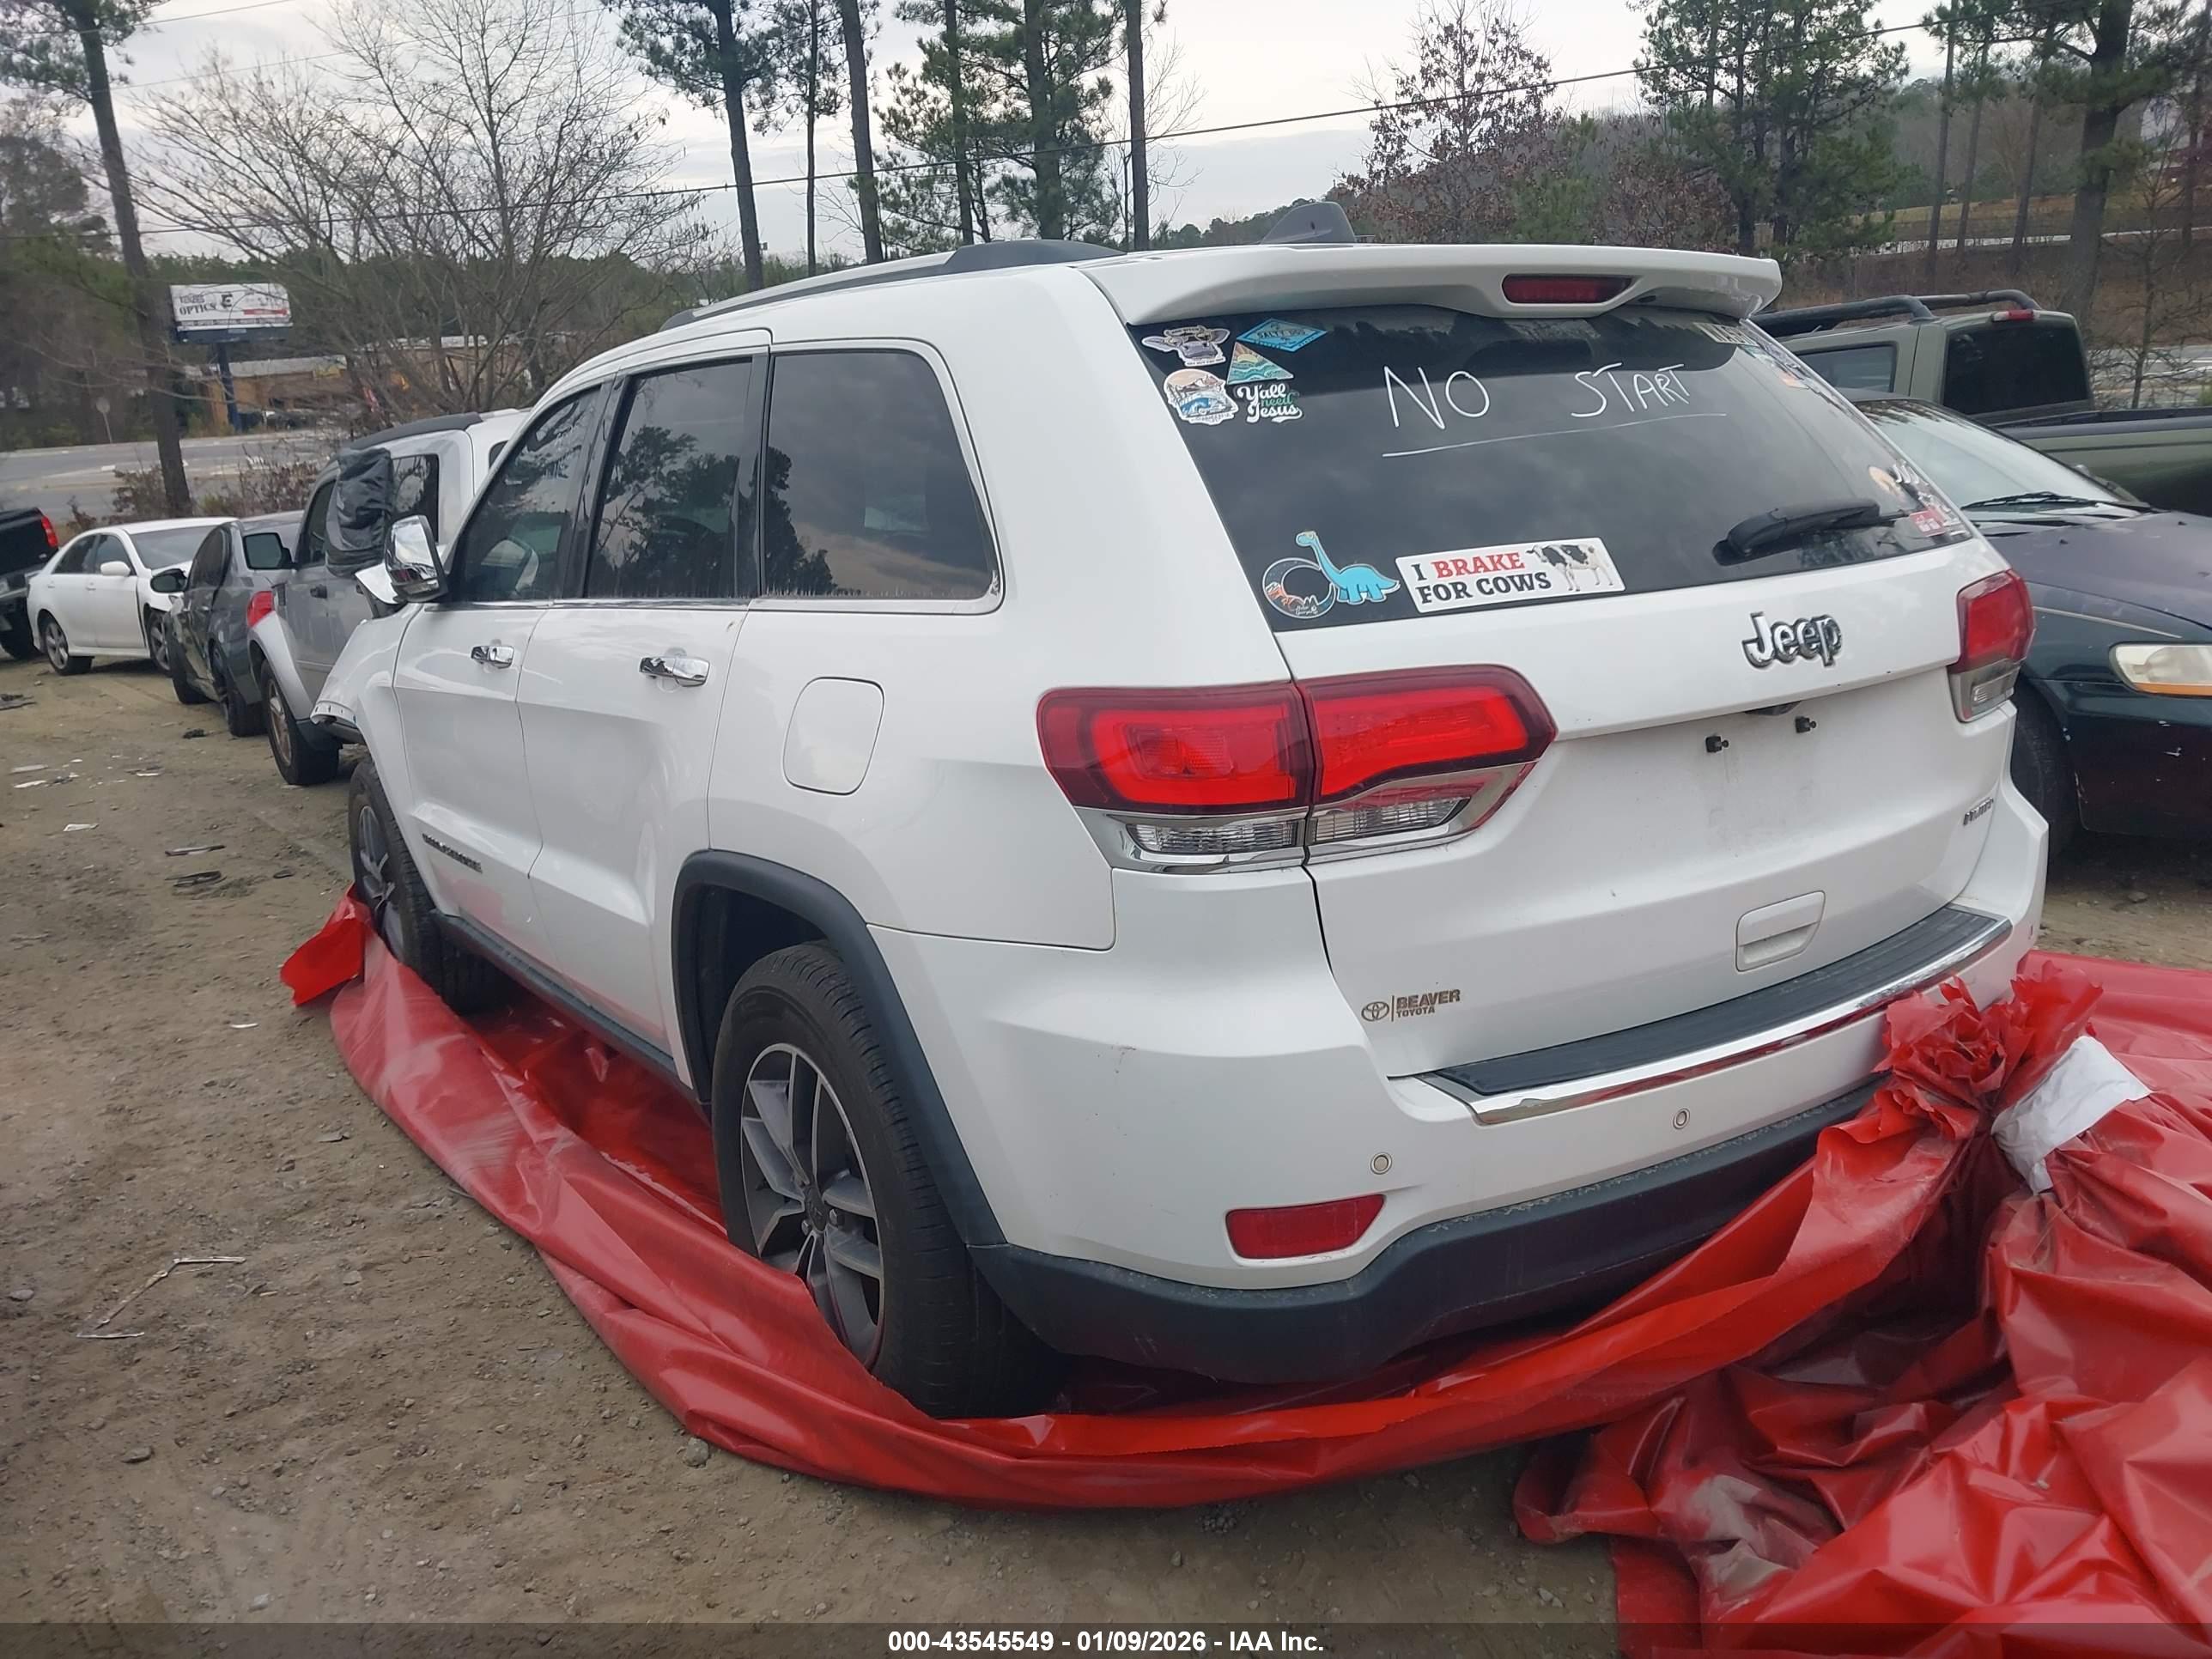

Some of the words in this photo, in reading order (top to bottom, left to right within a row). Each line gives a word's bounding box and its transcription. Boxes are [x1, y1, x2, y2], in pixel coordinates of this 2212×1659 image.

[179, 302, 216, 315] OPTICS
[1237, 383, 1286, 406] Y'all
[1261, 392, 1296, 407] need
[1383, 365, 1490, 429] NO
[1571, 362, 1691, 417] START
[1246, 403, 1303, 422] Jesus
[1411, 563, 1427, 581] I
[1431, 552, 1525, 579] BRAKE
[1415, 581, 1474, 604] FOR
[1476, 571, 1552, 595] COWS
[1741, 611, 1842, 668] Jeep
[1396, 989, 1461, 1010] BEAVER
[1396, 1006, 1435, 1018] TOYOTA
